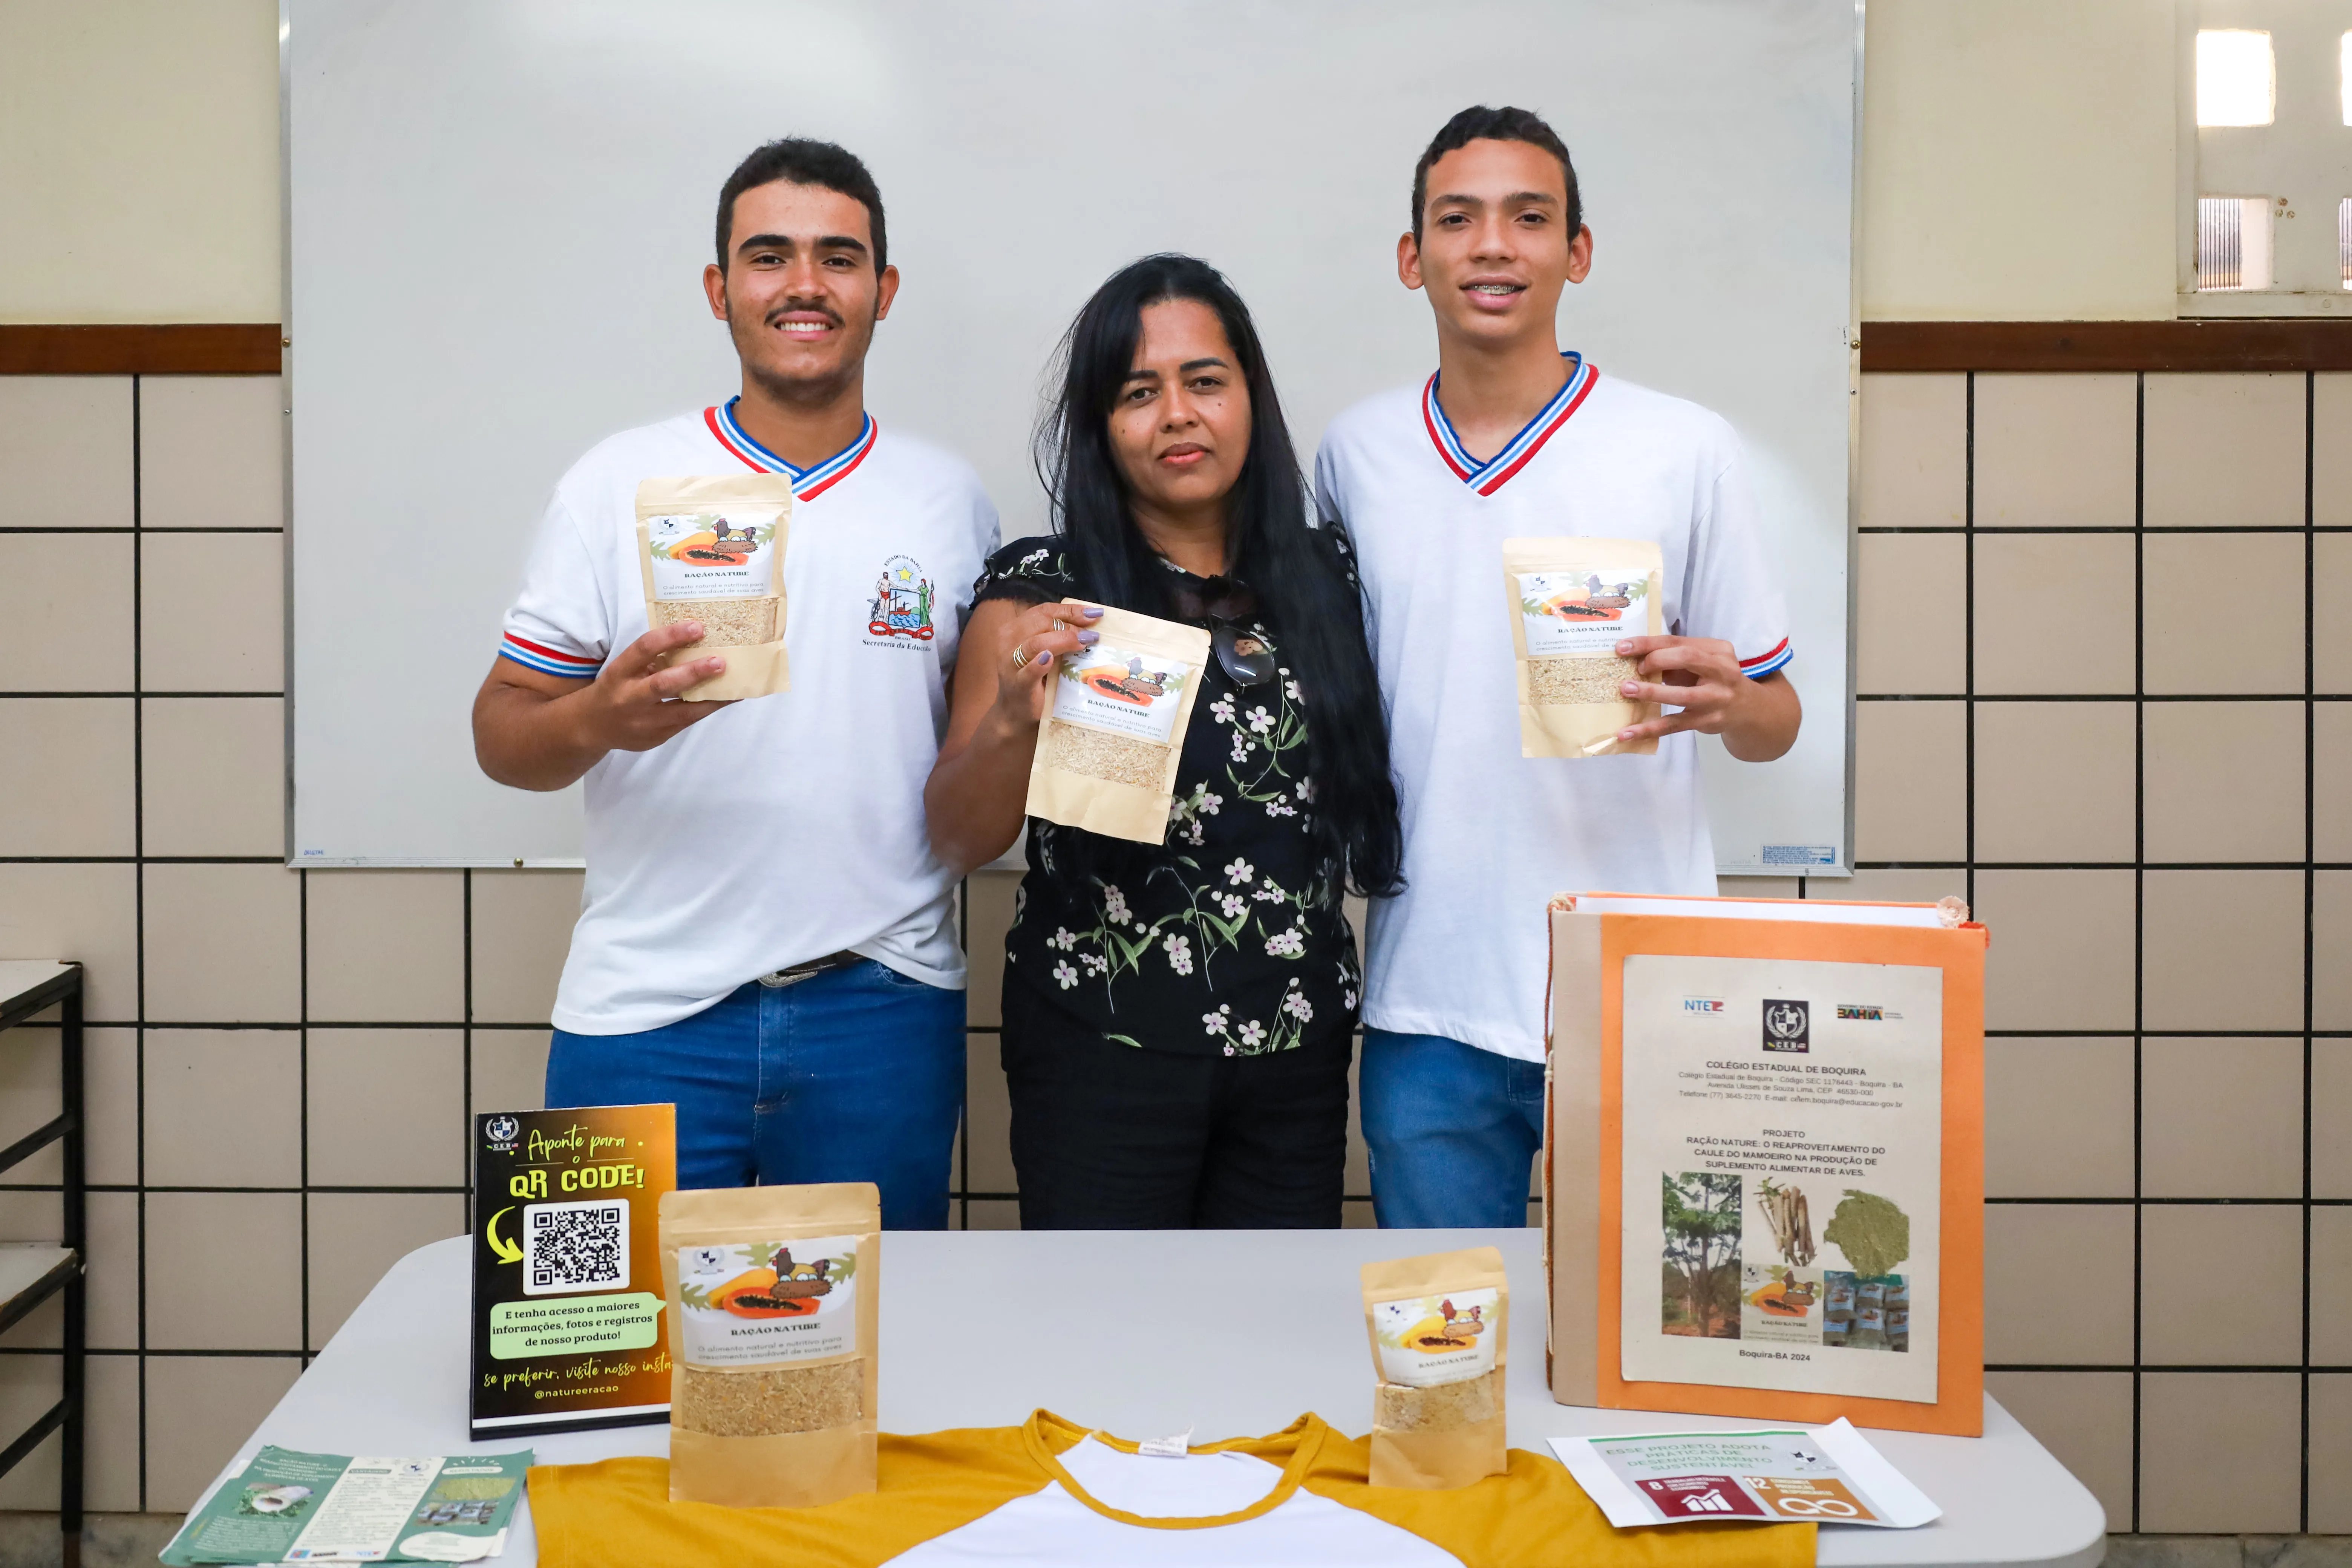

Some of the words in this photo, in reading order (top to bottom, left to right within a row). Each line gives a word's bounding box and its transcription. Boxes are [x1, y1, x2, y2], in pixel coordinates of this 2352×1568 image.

[884, 554, 902, 567] ESTADO
[910, 558, 922, 573] BAHIA
[862, 639, 895, 648] Secretaria
[1087, 699, 1116, 710] RAÇÃO
[1117, 706, 1150, 718] NATURE
[1061, 711, 1095, 721] crescimento
[1097, 718, 1123, 729] saudável
[1069, 706, 1094, 716] alimento
[1095, 711, 1116, 721] natural
[1123, 719, 1146, 728] nutritivo
[1838, 1009, 1883, 1020] BAHIA
[1706, 1060, 1750, 1069] COLÉGIO
[1752, 1063, 1803, 1073] ESTADUAL
[1821, 1066, 1867, 1076] BOQUIRA
[1747, 1075, 1773, 1083] Boquira
[1709, 1092, 1723, 1100] (77)
[1762, 1129, 1805, 1138] PROJETO
[528, 1124, 588, 1161] Aponte
[590, 1135, 625, 1158] para
[1686, 1136, 1719, 1146] RAÇÃO
[1721, 1139, 1761, 1147] NATURE:
[1772, 1141, 1870, 1153] REAPROVEITAMENTO
[572, 1155, 580, 1164] o
[1694, 1148, 1725, 1157] CAULE
[1743, 1152, 1793, 1161] MAMOEIRO
[1810, 1155, 1863, 1165] PRODUÇÃO
[1705, 1161, 1767, 1171] SUPLEMENTO
[1769, 1164, 1822, 1174] ALIMENTAR
[510, 1170, 548, 1199] QR
[561, 1164, 645, 1192] CODE!
[505, 1311, 512, 1319] E
[514, 1308, 547, 1318] tenha
[549, 1306, 585, 1316] acesso
[596, 1302, 640, 1312] maiores
[492, 1321, 564, 1335] informações,
[566, 1318, 594, 1329] fotos
[604, 1314, 653, 1327] registros
[731, 1326, 772, 1336] RAÇÃO
[773, 1322, 821, 1333] NATURE
[525, 1337, 538, 1347] de
[540, 1336, 572, 1345] nosso
[574, 1331, 620, 1344] produto!
[707, 1343, 744, 1352] alimento
[746, 1341, 776, 1351] natural
[786, 1337, 820, 1348] nutritivo
[821, 1335, 842, 1347] para
[750, 1348, 789, 1360] saudável
[791, 1347, 802, 1356] de
[824, 1344, 842, 1352] aves
[1449, 1354, 1479, 1364] NATURE
[1740, 1349, 1788, 1359] Boquira-BA
[484, 1372, 498, 1387] se
[566, 1357, 601, 1380] visite
[605, 1363, 636, 1377] nosso
[1606, 1447, 1644, 1455] ESSE
[1648, 1443, 1717, 1452] PROJETO
[1645, 1449, 1720, 1458] PRÁTICAS
[1627, 1456, 1773, 1467] DESENVOLVIMENTO
[1651, 1462, 1756, 1471] SUSTENTÁVEL
[1648, 1481, 1664, 1490] 8
[1744, 1477, 1771, 1489] 12
